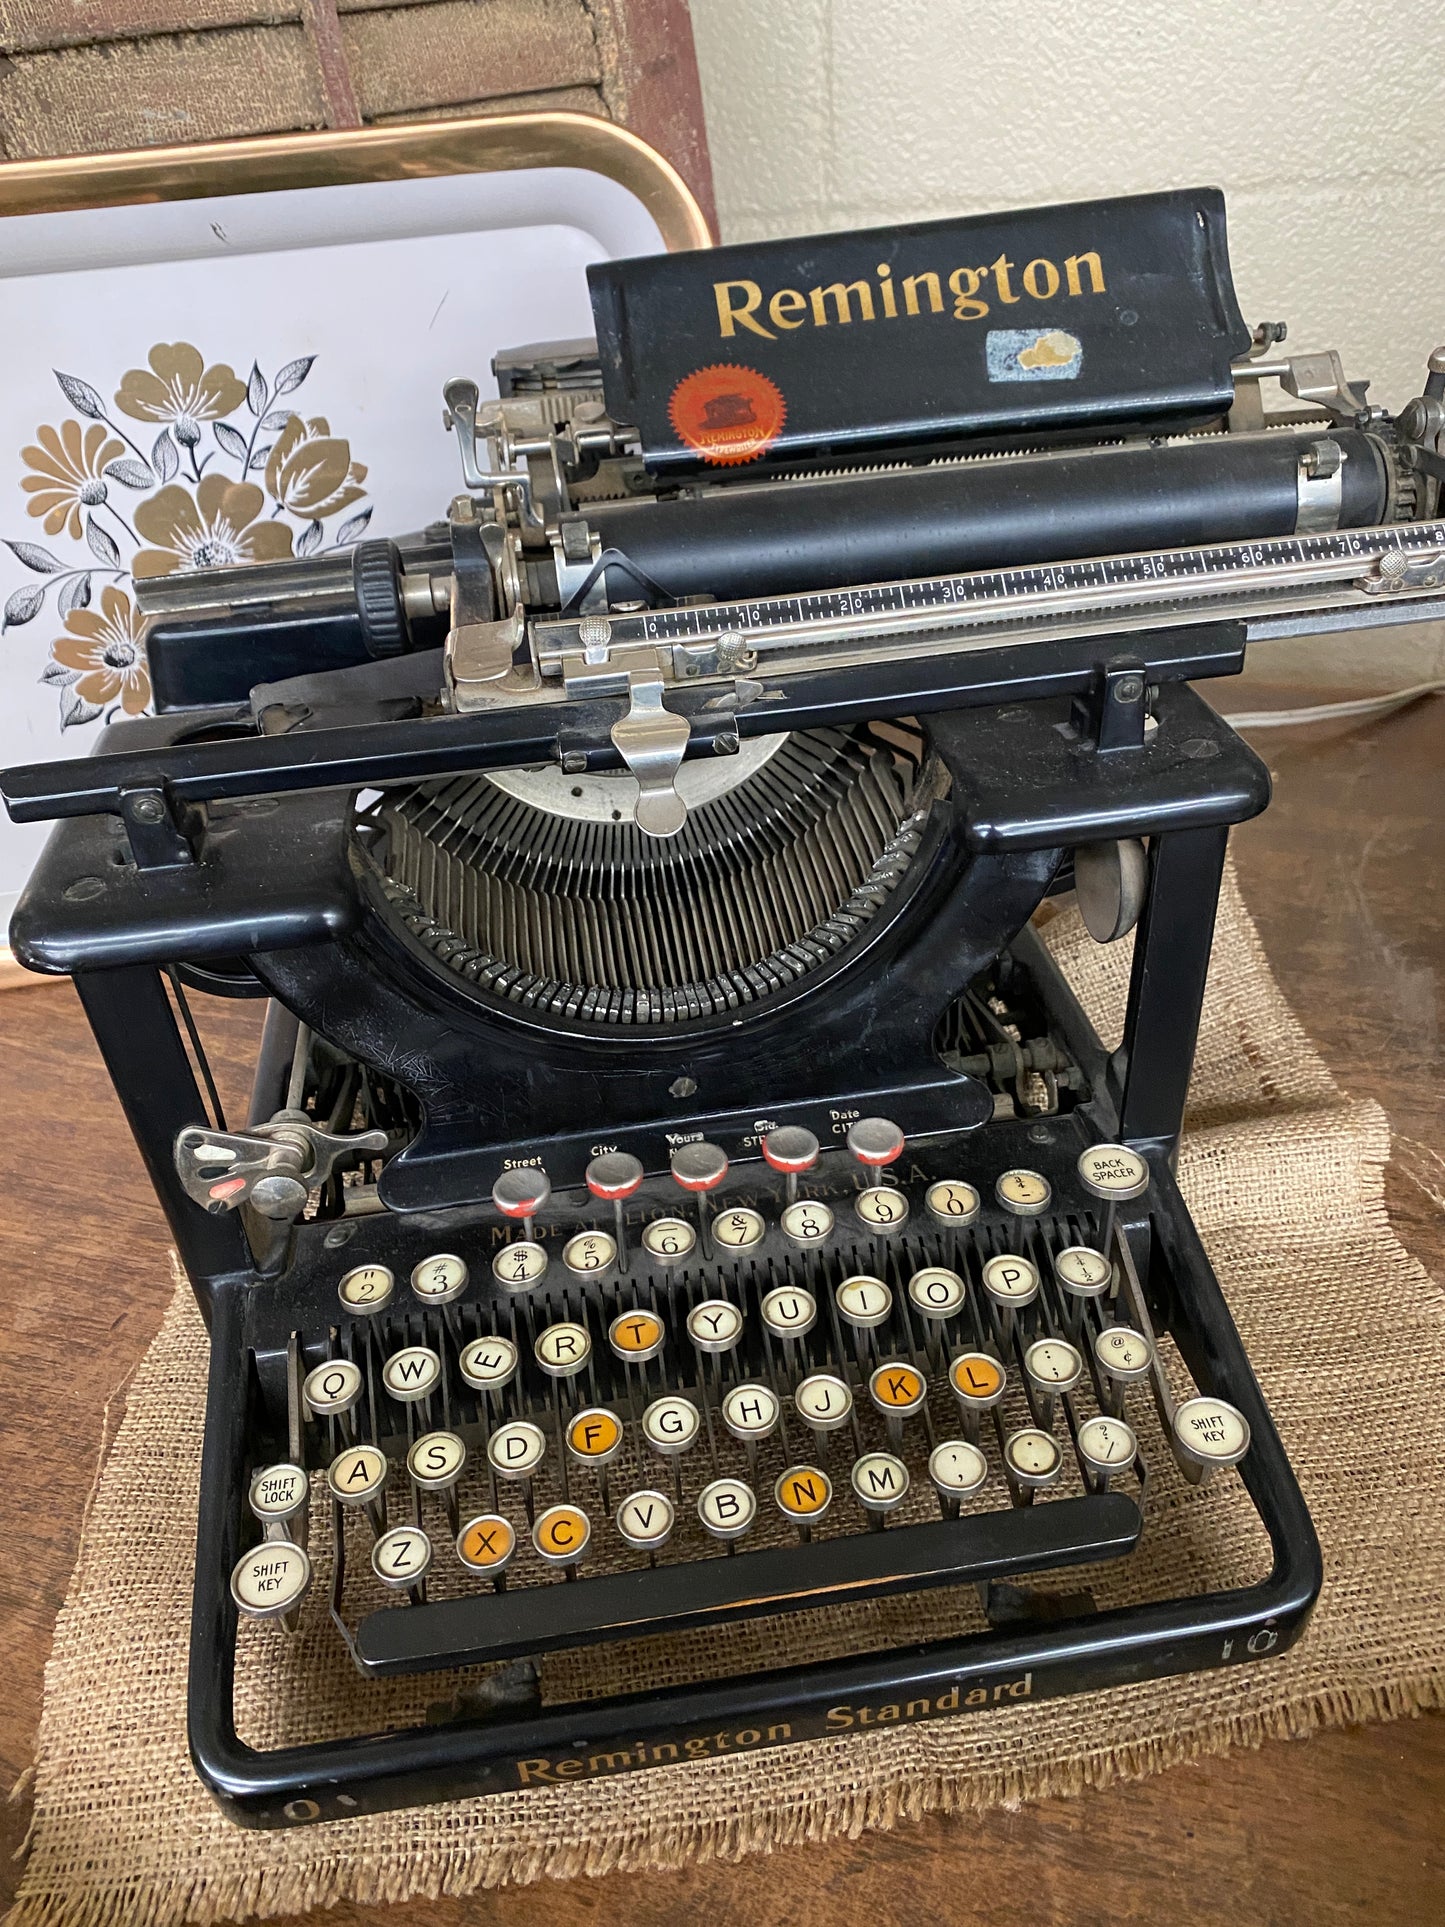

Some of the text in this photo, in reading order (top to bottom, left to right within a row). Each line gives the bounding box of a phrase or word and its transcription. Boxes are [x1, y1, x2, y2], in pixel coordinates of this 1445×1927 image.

[713, 250, 1106, 340] Remington
[649, 622, 657, 633] 0
[739, 610, 760, 624] 10
[840, 598, 862, 612] 20
[941, 585, 964, 599] 30
[1043, 573, 1065, 587] 40
[1143, 562, 1165, 576] 50
[1241, 551, 1263, 564] 60
[1339, 540, 1361, 553] 70
[830, 1110, 860, 1121] Date
[503, 1156, 542, 1169] Street
[1093, 1159, 1125, 1170] BACK
[1092, 1168, 1136, 1182] SPACER
[491, 1223, 562, 1246] MADE
[766, 1182, 849, 1204] YRK,
[731, 1215, 747, 1226] &
[876, 1204, 893, 1222] 9
[733, 1226, 748, 1243] 7
[801, 1219, 820, 1237] 8
[661, 1237, 678, 1254] 6
[584, 1250, 600, 1269] 5
[512, 1263, 529, 1281] 4
[1001, 1269, 1020, 1290] P
[357, 1284, 375, 1303] 2
[431, 1274, 449, 1294] 3
[926, 1282, 949, 1303] O
[779, 1299, 799, 1320] U
[860, 1290, 868, 1310] I
[703, 1312, 723, 1333] Y
[626, 1323, 646, 1344] T
[555, 1335, 577, 1358] R
[474, 1351, 502, 1368] E
[399, 1359, 426, 1382] W
[966, 1366, 989, 1388] L
[323, 1372, 345, 1398] Q
[888, 1375, 912, 1400] K
[740, 1399, 762, 1423] H
[815, 1390, 831, 1411] J
[659, 1410, 683, 1433] G
[1190, 1415, 1224, 1430] SHIFT
[584, 1425, 602, 1449] F
[1203, 1430, 1225, 1442] KEY
[426, 1446, 447, 1470] S
[506, 1437, 528, 1460] D
[347, 1460, 369, 1484] A
[868, 1467, 896, 1492] M
[261, 1477, 296, 1492] SHIFT
[792, 1478, 817, 1506] N
[264, 1489, 294, 1504] LOCK
[715, 1493, 740, 1519] B
[633, 1504, 654, 1529] V
[473, 1530, 497, 1556] X
[550, 1520, 573, 1546] C
[391, 1541, 412, 1568] Z
[253, 1561, 289, 1577] SHIFT
[258, 1577, 283, 1592] KEY
[515, 1672, 1033, 1785] Remington Standard
